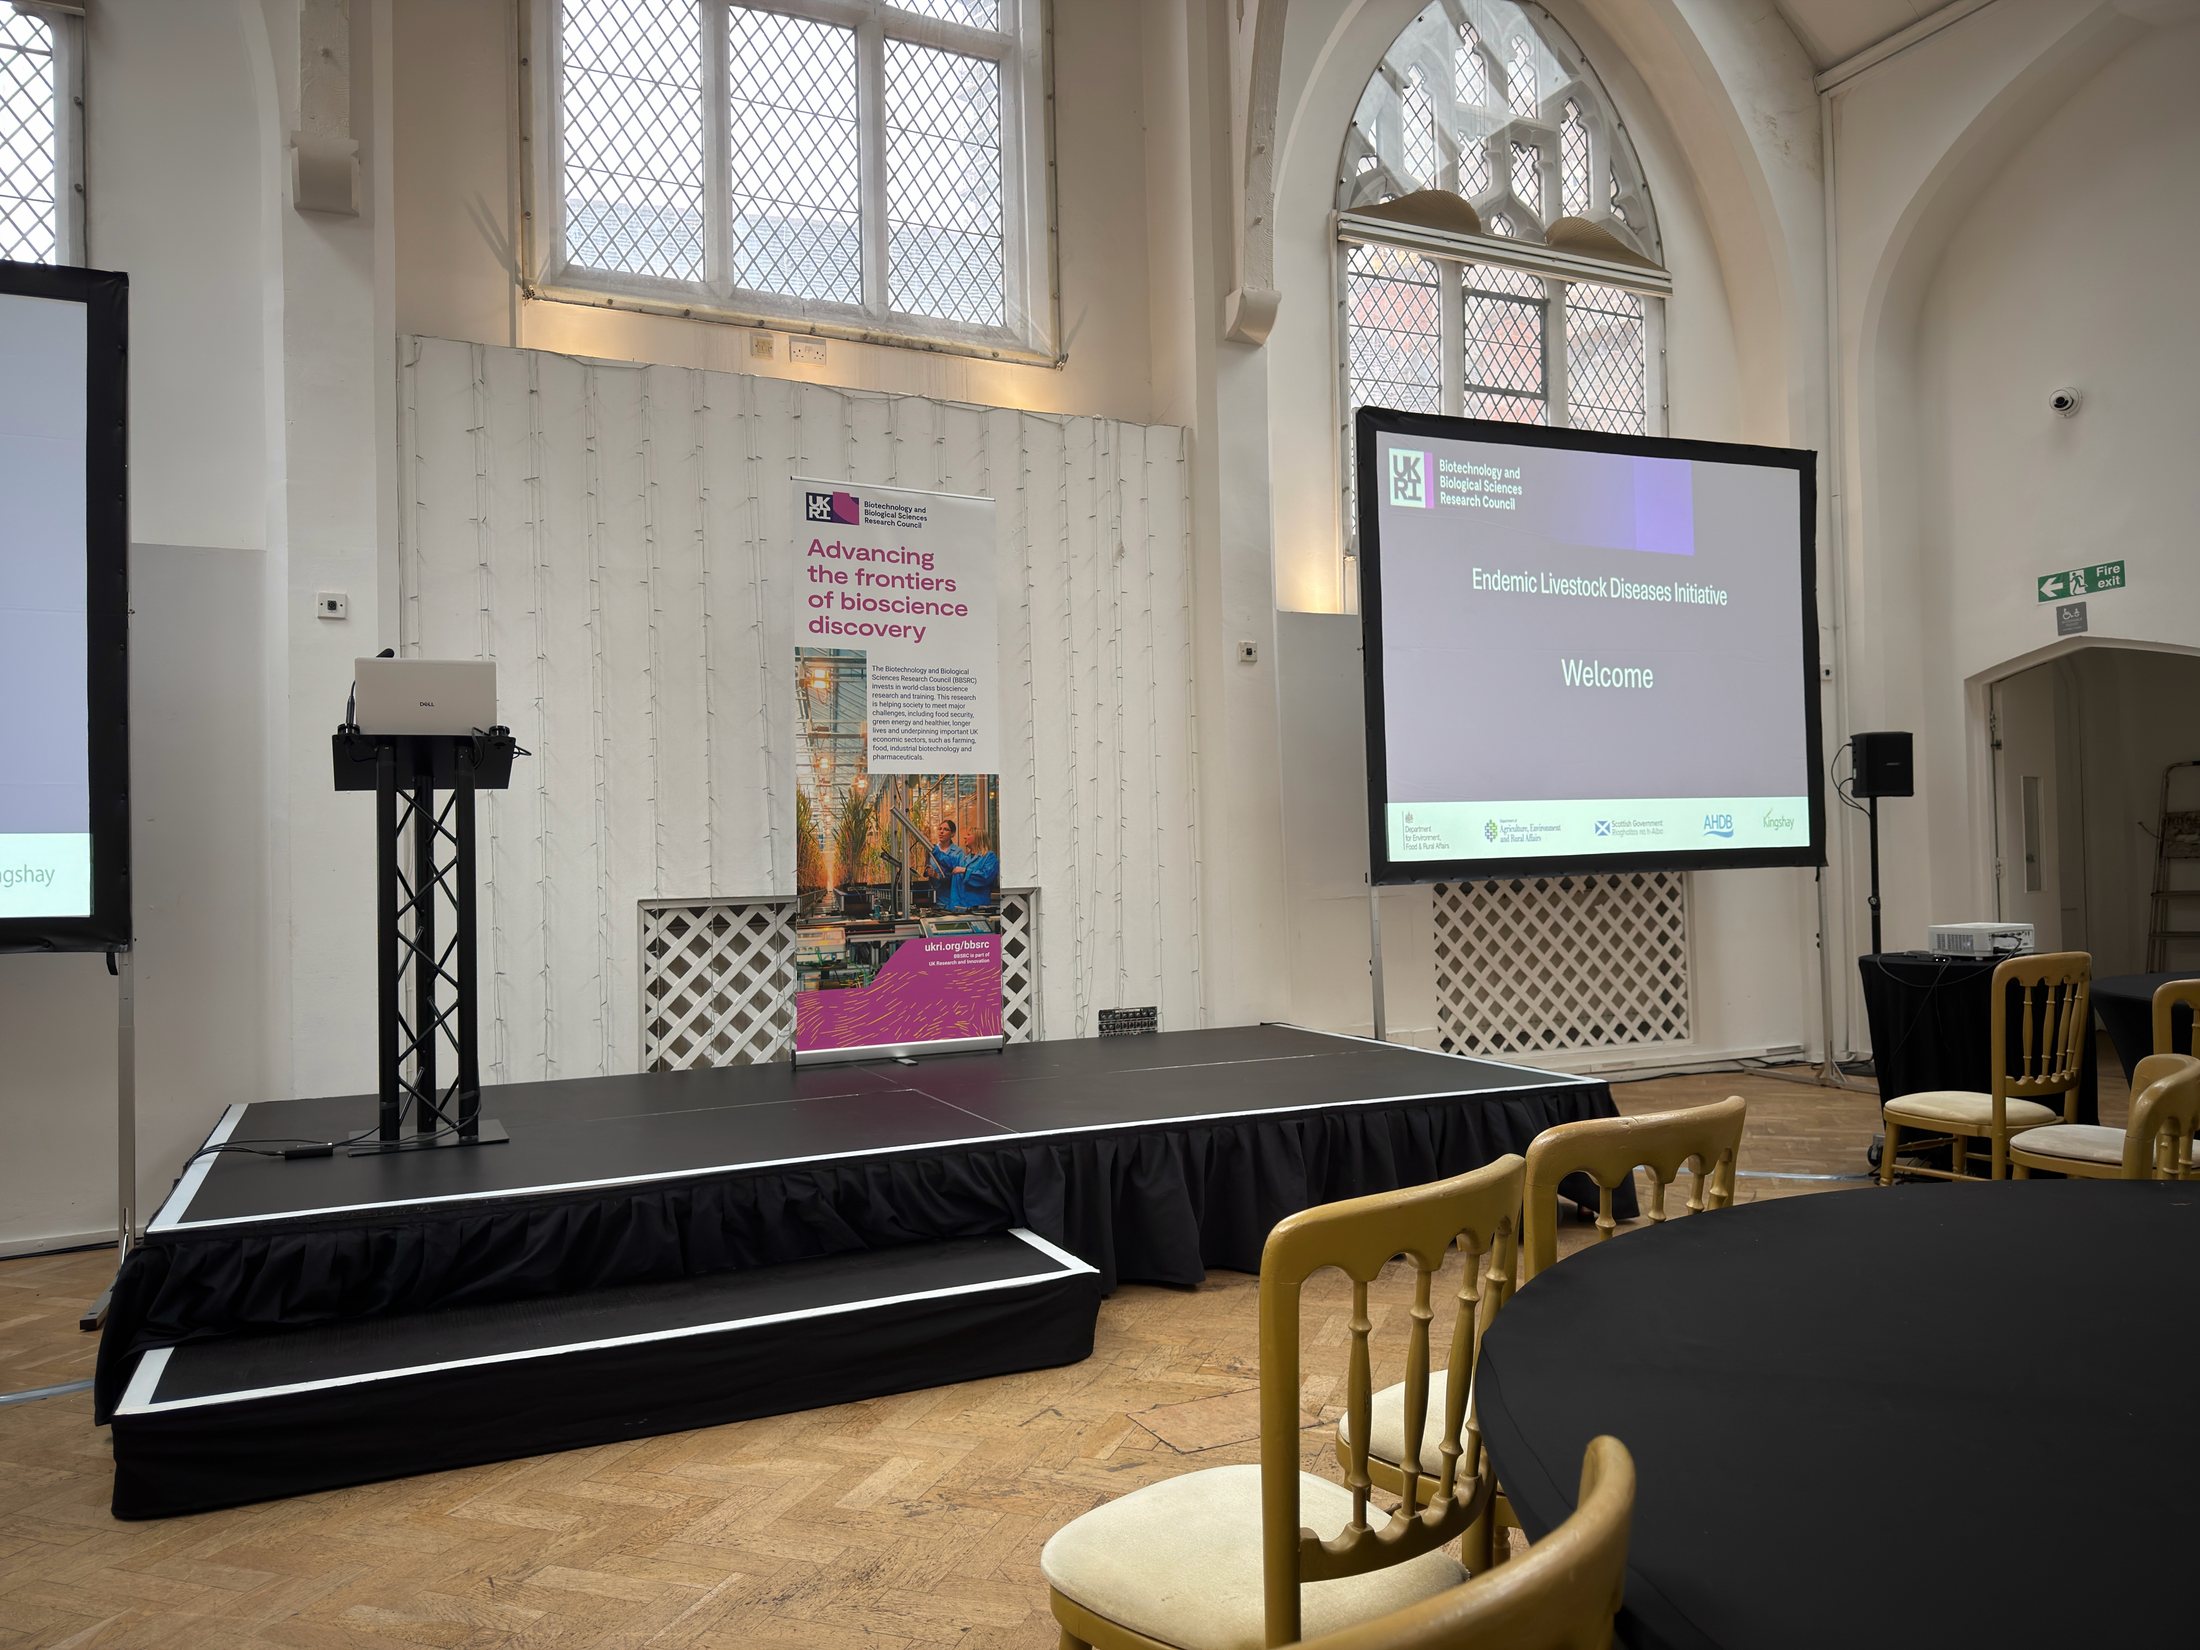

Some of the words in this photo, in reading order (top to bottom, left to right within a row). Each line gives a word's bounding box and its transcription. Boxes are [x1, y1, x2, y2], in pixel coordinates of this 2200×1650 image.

[1439, 459, 1502, 479] Biotechnology
[1504, 467, 1520, 479] and
[1440, 475, 1482, 492] Biological
[1483, 481, 1522, 496] Sciences
[864, 501, 913, 514] Biotechnology
[914, 506, 926, 514] and
[1440, 491, 1481, 507] Research
[1482, 497, 1516, 510] Council
[864, 509, 897, 519] Biological
[898, 512, 928, 521] Sciences
[864, 517, 895, 527] Research
[897, 519, 922, 528] Council
[808, 539, 935, 571] Advancing
[808, 565, 848, 585] the
[855, 568, 956, 592] frontiers
[2096, 565, 2120, 577] Fire
[1472, 567, 1537, 593] Endemic
[1540, 572, 1607, 598] Livestock
[1610, 577, 1671, 602] Diseases
[1675, 582, 1728, 606] Initiative
[2098, 576, 2120, 588] exit
[808, 591, 834, 609] of
[842, 592, 968, 616] bioscience
[809, 616, 926, 643] discovery
[885, 666, 927, 674] Biotechnology
[1561, 658, 1653, 689] Welcome
[1704, 814, 1733, 830] AHDB
[1763, 808, 1794, 830] Kingshay
[0, 864, 55, 887] gshay
[925, 940, 990, 952] ukri.org/bbsrc
